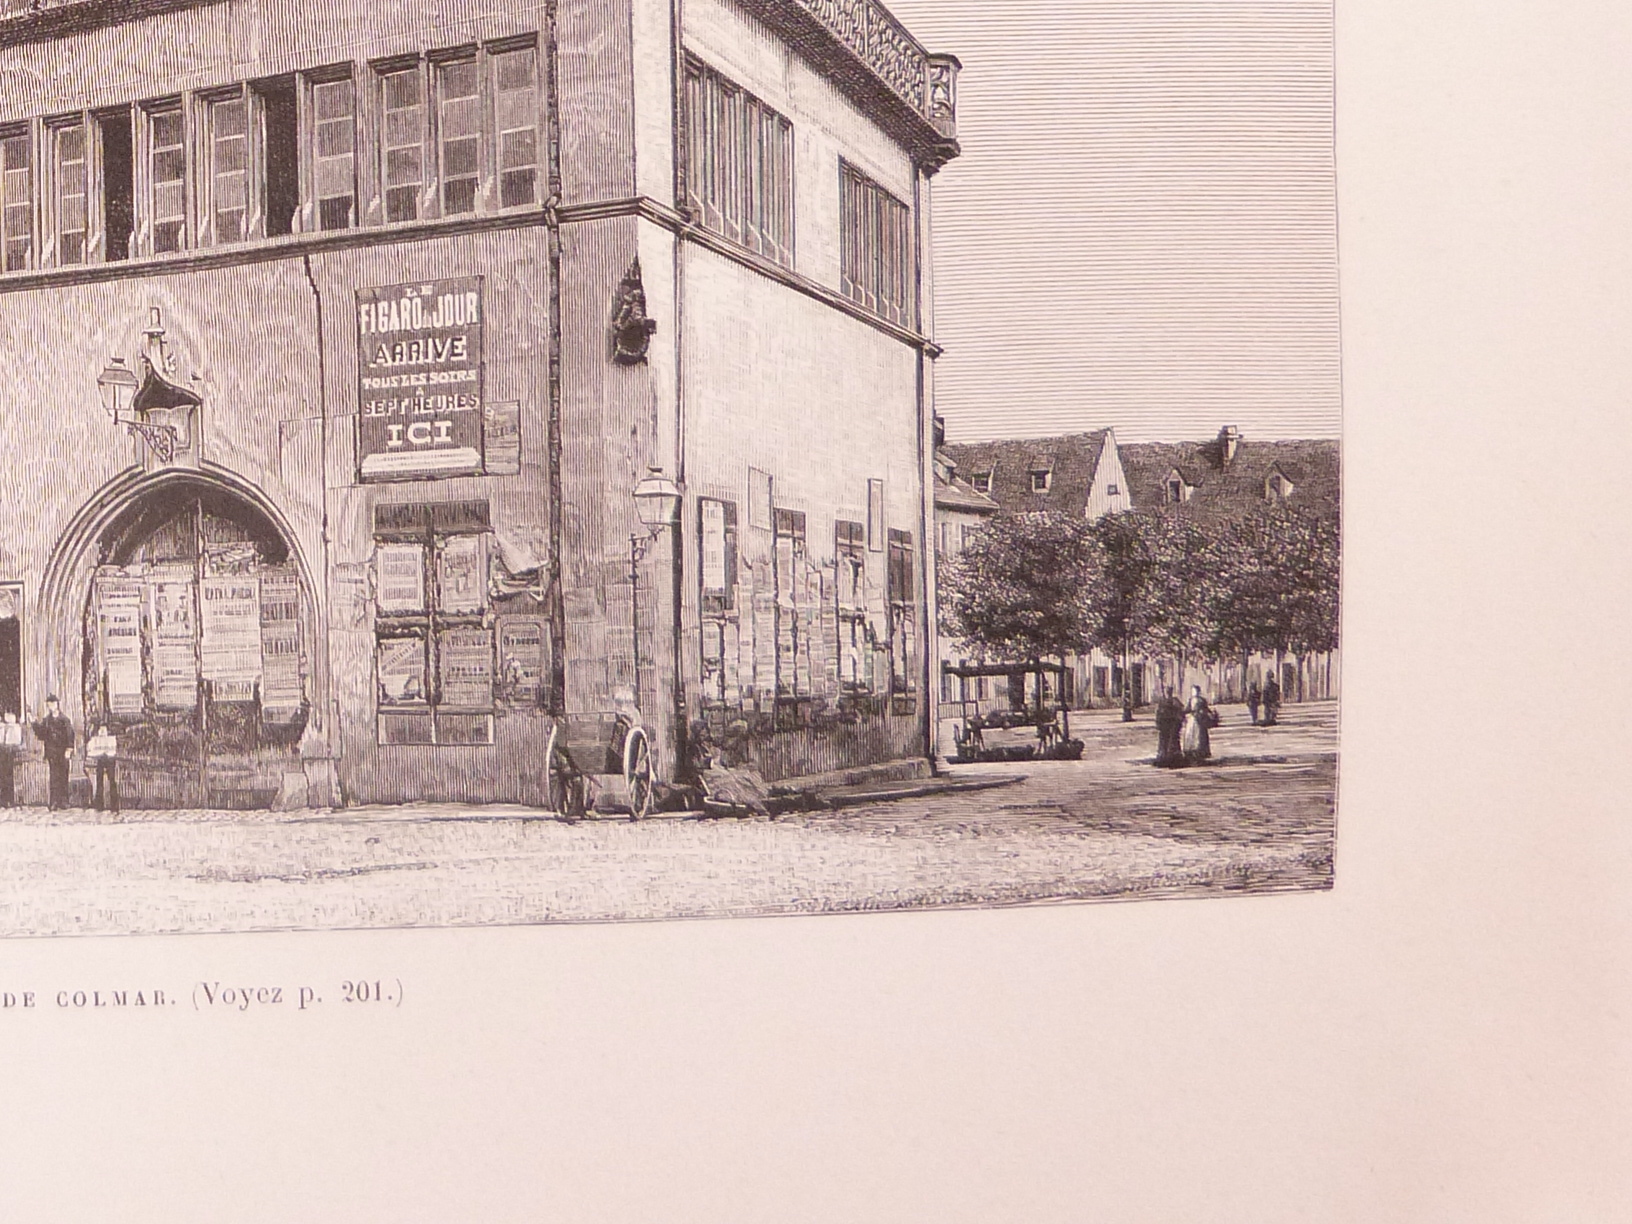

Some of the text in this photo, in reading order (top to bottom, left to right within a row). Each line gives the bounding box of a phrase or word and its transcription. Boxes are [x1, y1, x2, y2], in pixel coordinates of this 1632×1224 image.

[405, 284, 434, 297] LE
[360, 297, 422, 334] FIGARO
[432, 292, 478, 328] JOUR
[369, 336, 467, 368] ARRIVE
[362, 369, 477, 390] TOUS LES SOIRS
[364, 392, 480, 417] SEPT HEURES
[387, 420, 453, 447] ICI
[2, 991, 36, 1009] DE
[56, 989, 176, 1008] COLMAR.
[191, 980, 283, 1012] (Voyez
[297, 985, 323, 1012] p.
[341, 978, 405, 1009] 201.)
